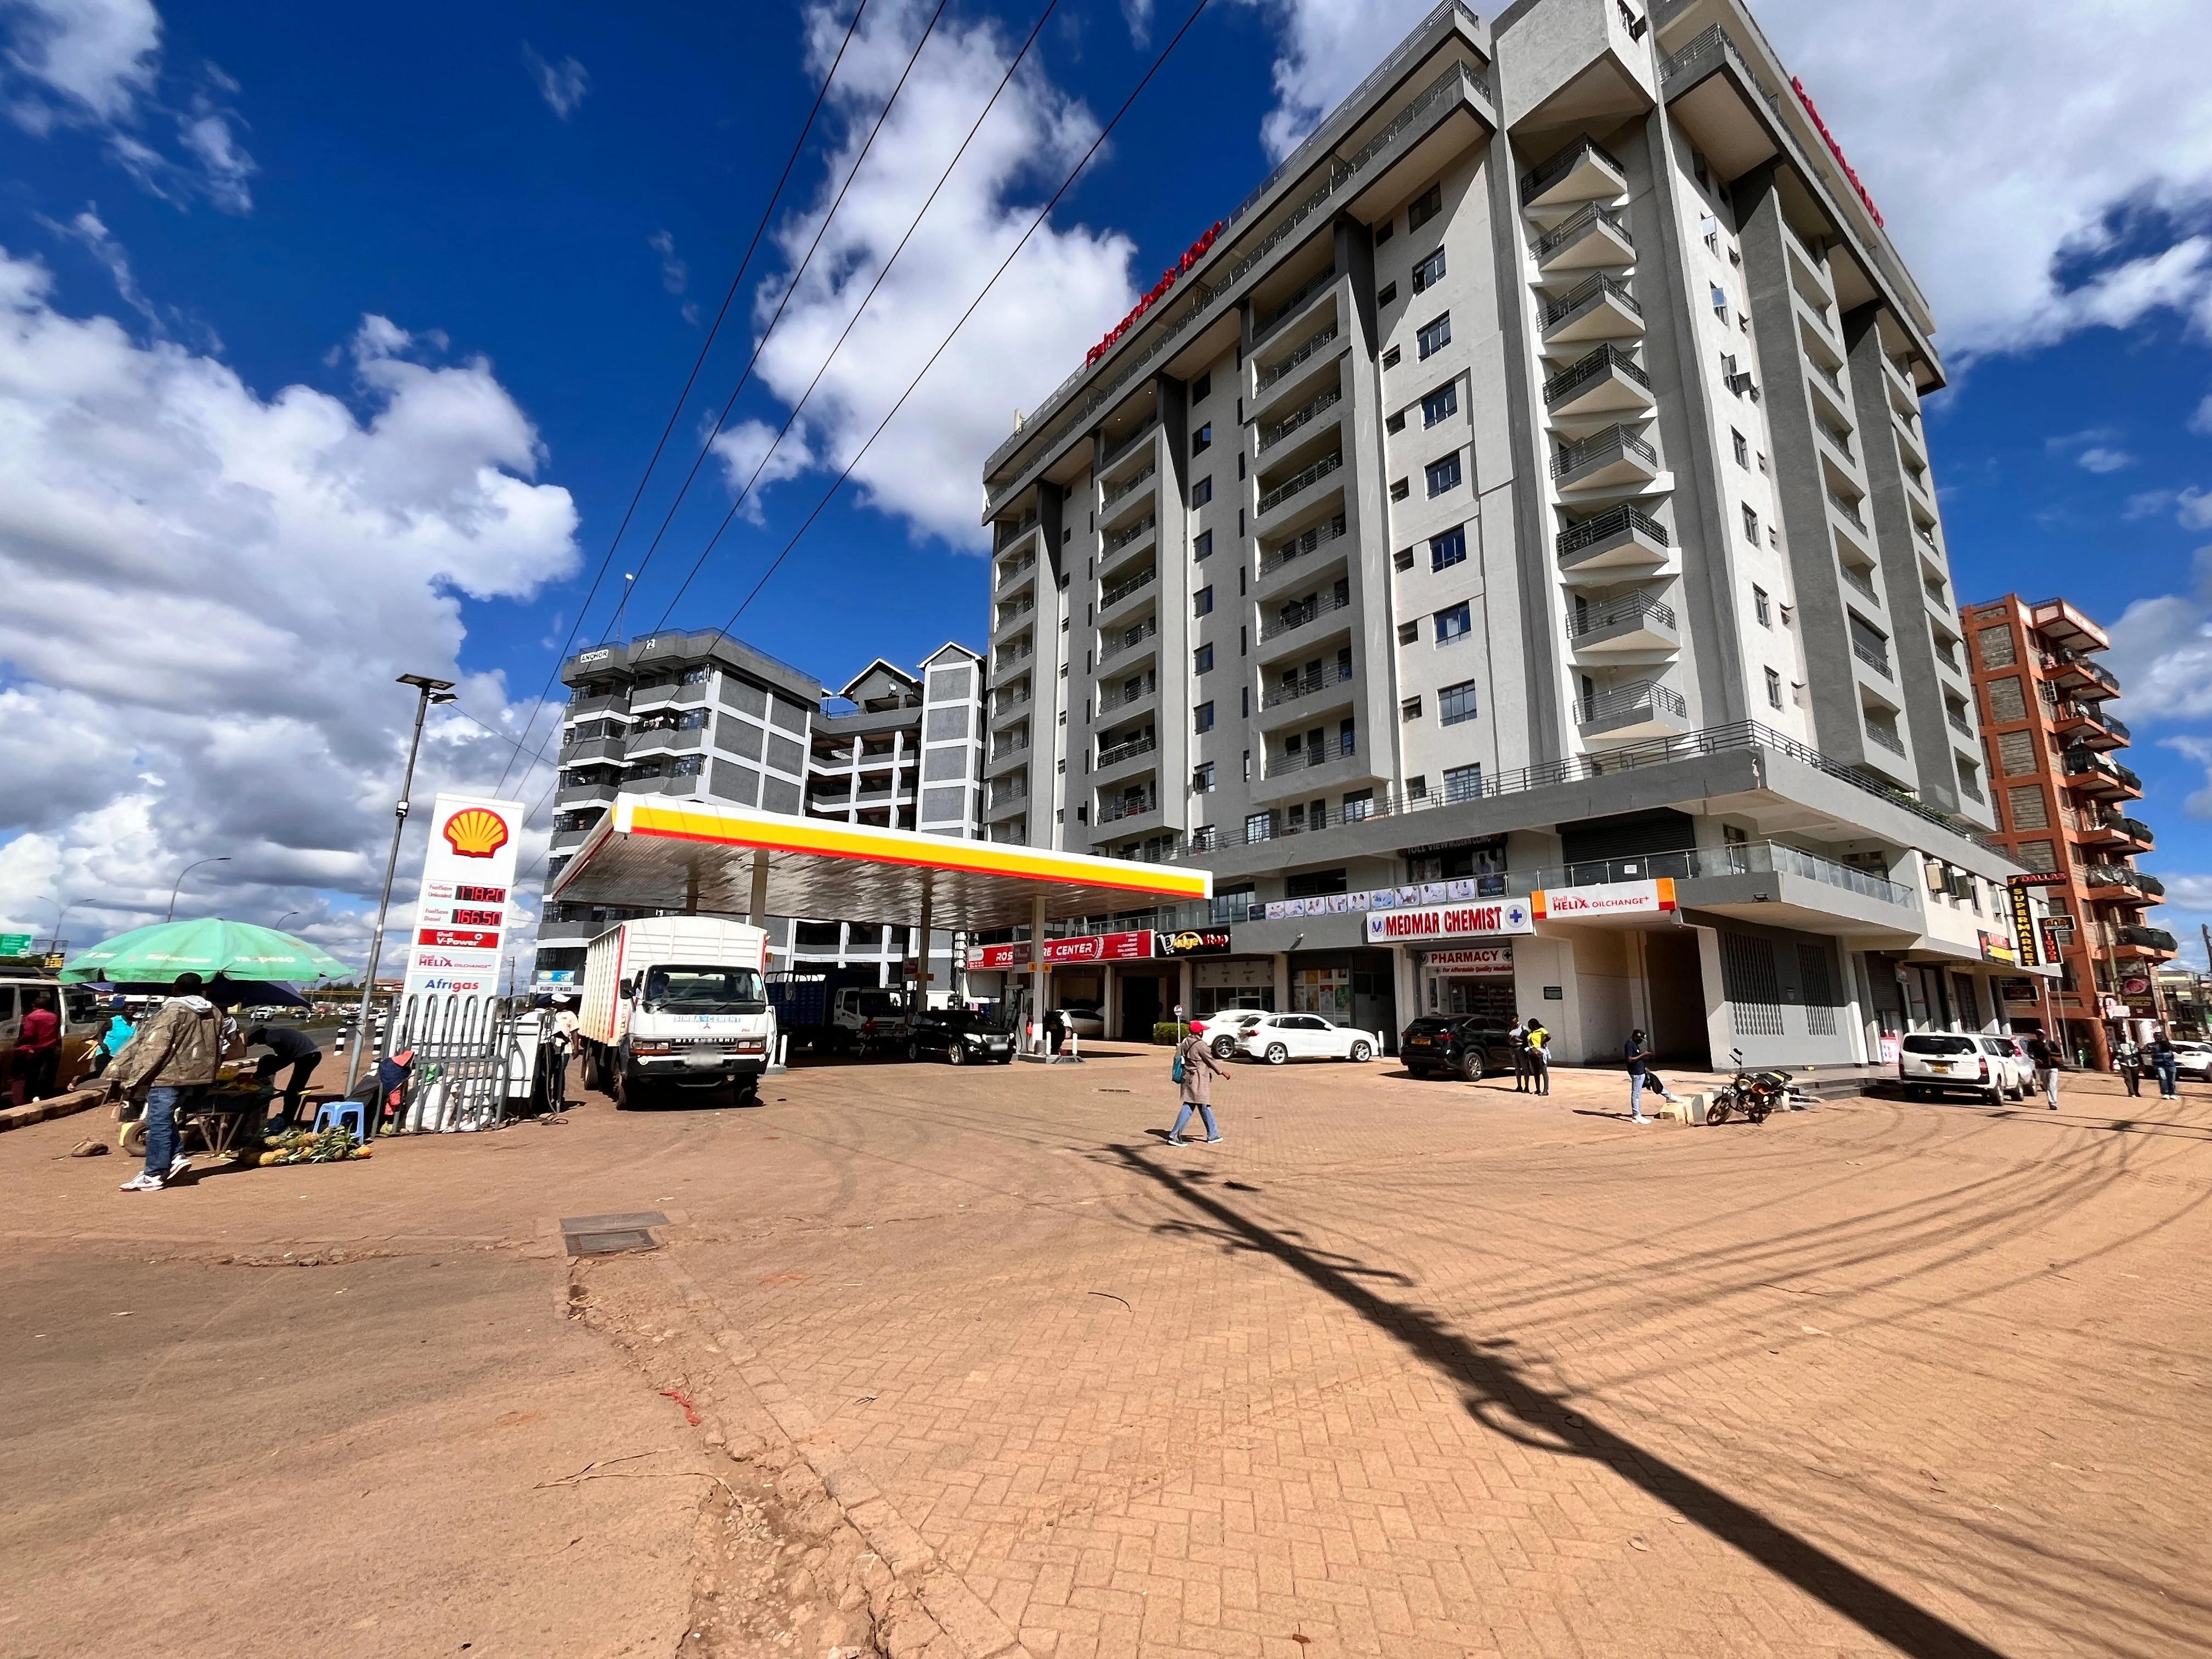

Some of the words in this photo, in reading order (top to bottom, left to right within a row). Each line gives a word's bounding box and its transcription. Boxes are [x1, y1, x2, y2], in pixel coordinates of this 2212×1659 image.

[582, 651, 607, 661] ANCHOR
[1428, 840, 1448, 851] VIEW
[2021, 873, 2066, 882] DALLAS
[1554, 899, 1589, 911] HELIX
[1386, 912, 1440, 936] MEDMAR
[1444, 906, 1502, 933] CHEMIST
[2013, 888, 2034, 966] SUPERMARKET
[437, 937, 479, 946] V-Power
[2045, 930, 2057, 961] LIQUOR
[996, 951, 1013, 962] ROS
[1056, 943, 1092, 956] CENTER
[1431, 950, 1498, 964] PHARMACY
[419, 957, 453, 967] HELIX
[425, 978, 479, 992] Afrigas
